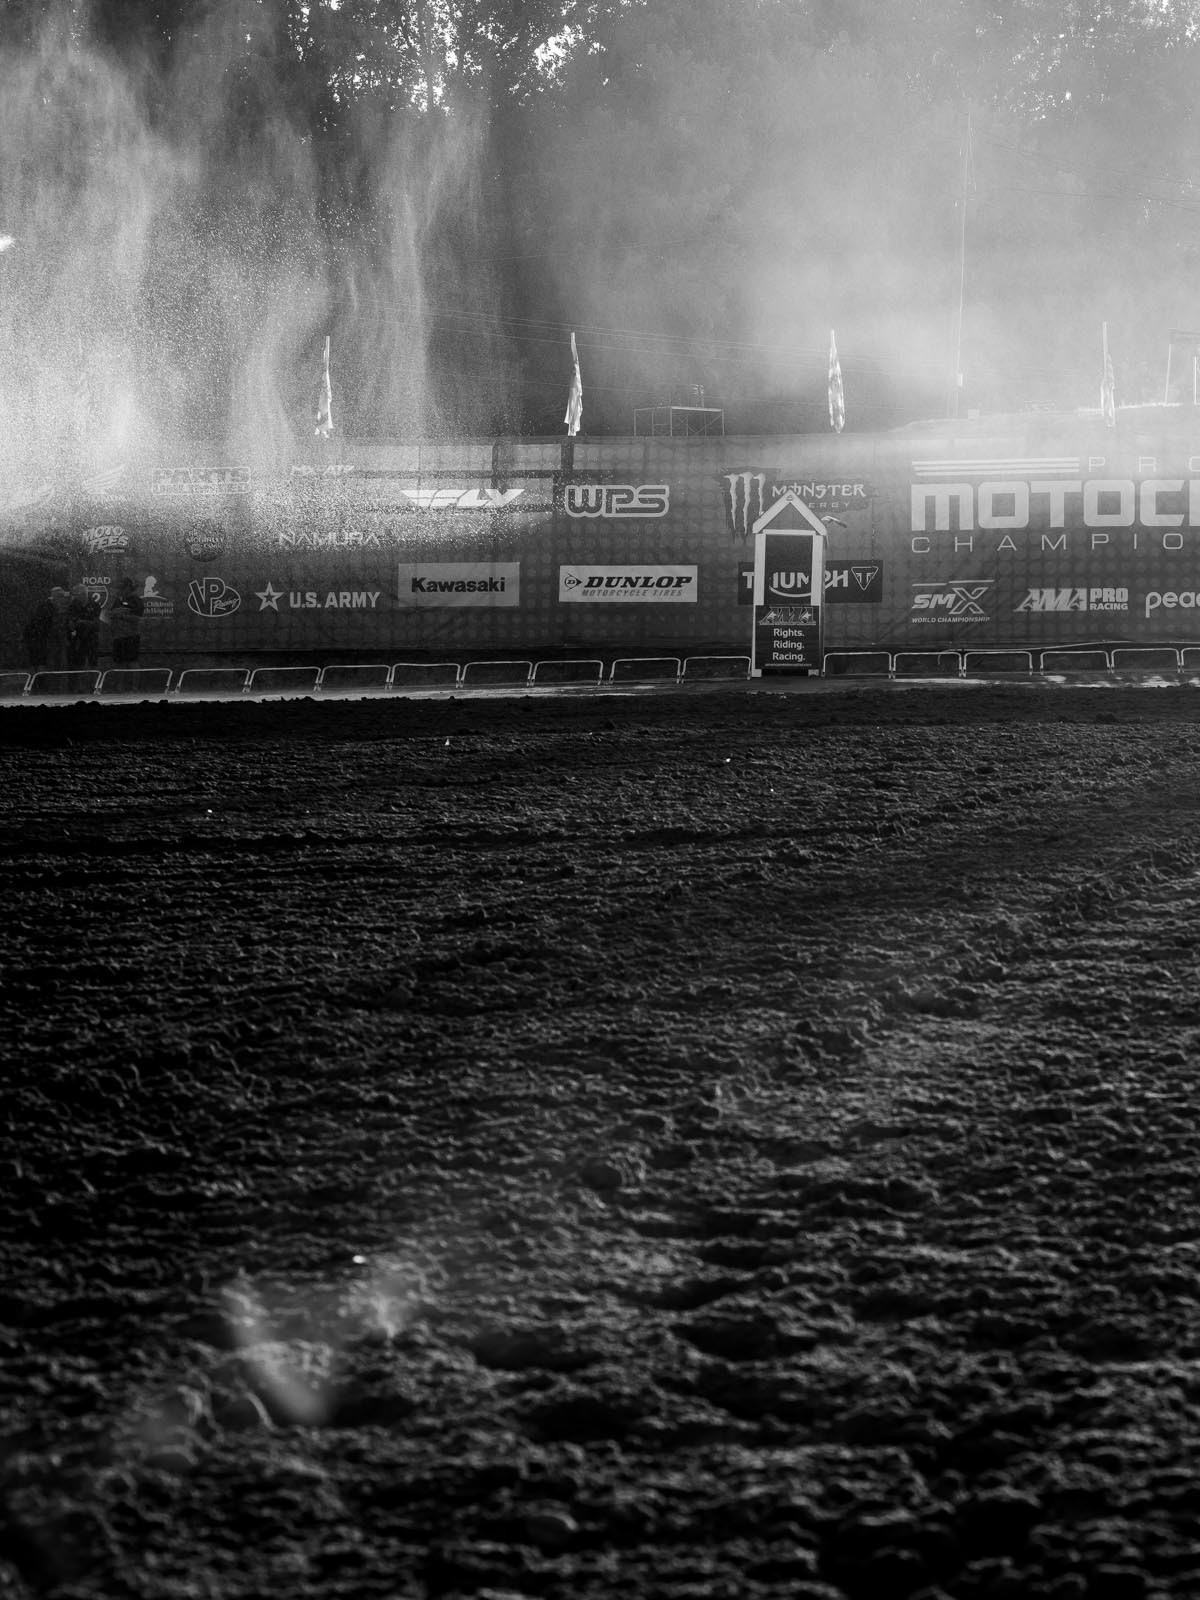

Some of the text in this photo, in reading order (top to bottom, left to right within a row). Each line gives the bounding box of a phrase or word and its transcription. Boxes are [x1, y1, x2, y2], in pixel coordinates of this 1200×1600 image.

[400, 488, 526, 509] FLY
[772, 481, 867, 499] MONSTER
[565, 484, 670, 518] WPS
[82, 526, 125, 545] MOTO
[89, 535, 130, 554] TEES
[278, 531, 381, 547] NAMURA
[82, 577, 112, 585] ROAD
[411, 576, 506, 594] Kawasaki
[584, 576, 693, 588] DUNLOP
[742, 570, 849, 589] TIUMH
[188, 577, 226, 617] VP
[289, 591, 381, 608] U.S. ARMY
[581, 589, 684, 597] MOTORCYCLE TIRES
[911, 587, 988, 614] SMX
[1012, 588, 1088, 612] AMA
[1090, 588, 1129, 603] PRO
[1090, 602, 1129, 611] RACING
[758, 606, 817, 626] AMA
[773, 628, 805, 639] Rights.
[773, 640, 805, 651] Riding.
[772, 652, 806, 662] Racing.
